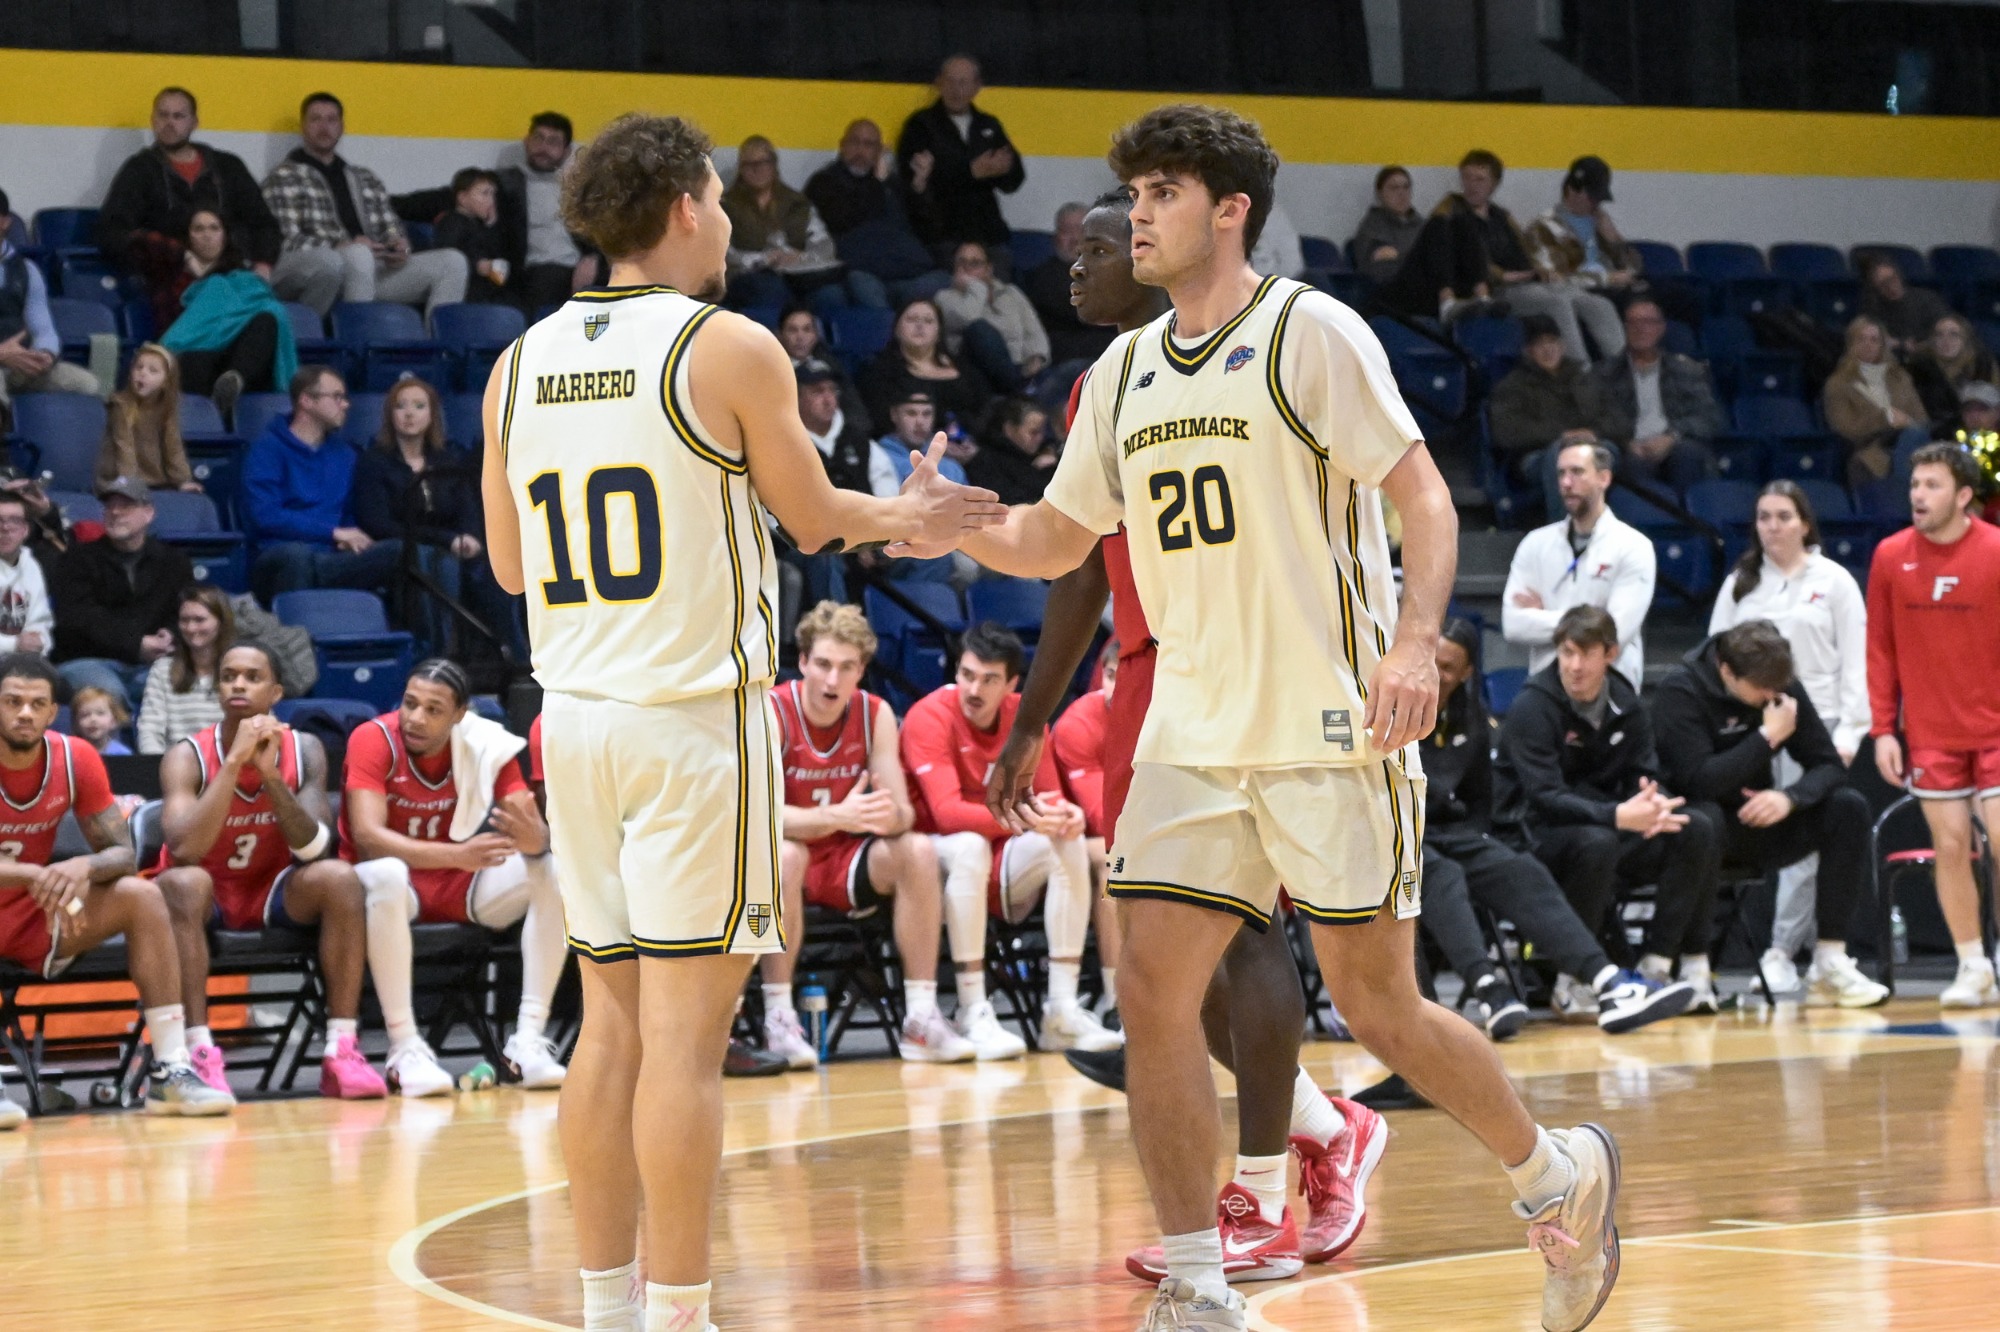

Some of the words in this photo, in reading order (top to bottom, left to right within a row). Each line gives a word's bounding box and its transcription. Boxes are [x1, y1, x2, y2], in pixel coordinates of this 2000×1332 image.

[536, 368, 636, 405] MARRERO
[1123, 416, 1250, 460] MERRIMACK
[1148, 463, 1237, 553] 20
[526, 464, 665, 608] 10
[1932, 575, 1960, 602] F
[227, 833, 258, 870] 3
